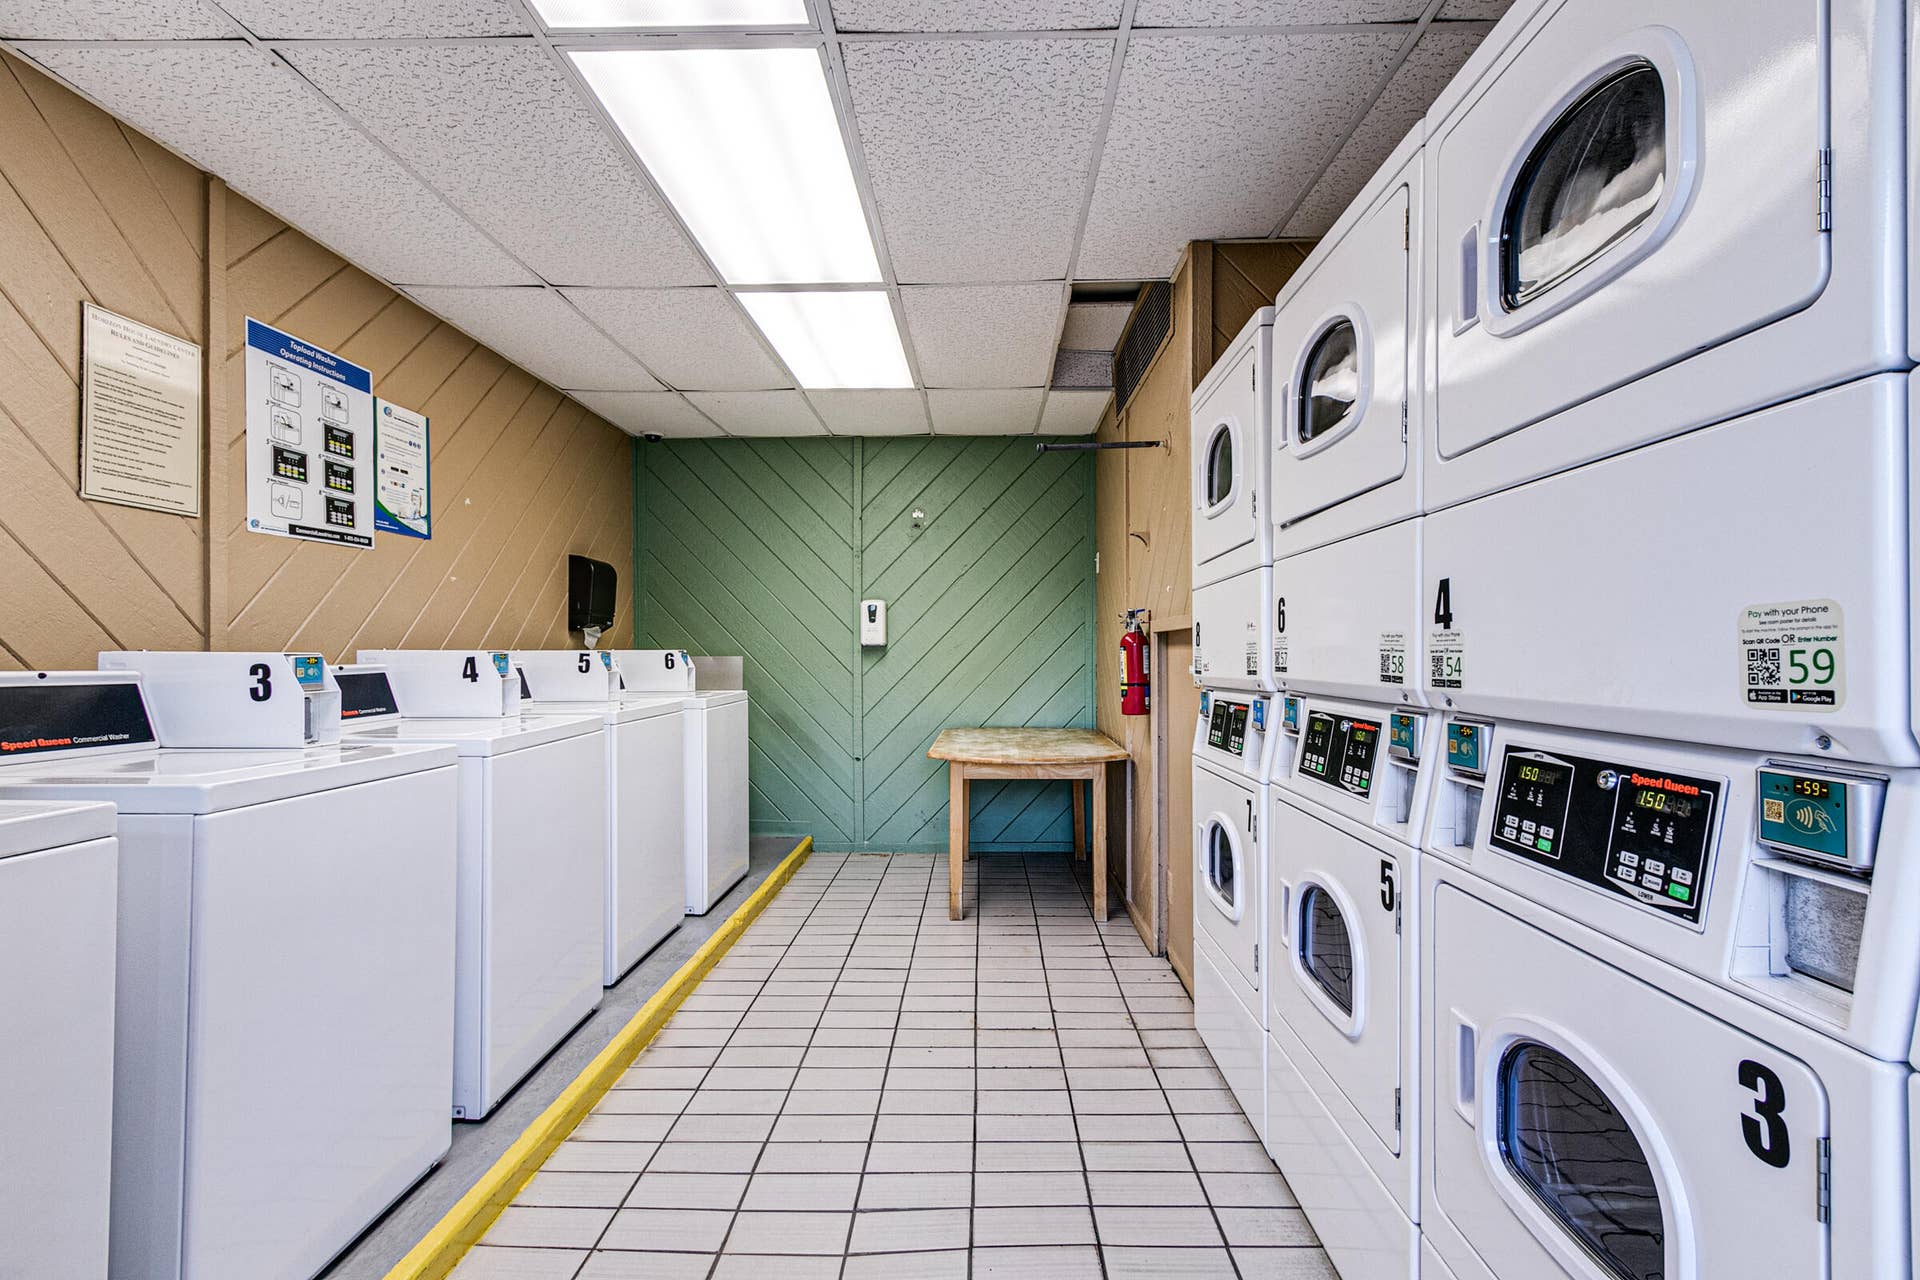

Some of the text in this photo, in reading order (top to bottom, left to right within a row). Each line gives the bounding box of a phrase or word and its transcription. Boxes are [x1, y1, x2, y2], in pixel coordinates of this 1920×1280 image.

[280, 348, 312, 368] Operating
[313, 362, 346, 382] Instructions
[290, 340, 337, 367] Topload Washer
[1278, 597, 1286, 634] 6
[1435, 578, 1453, 630] 4
[1747, 605, 1829, 619] Pay with your Phone
[1195, 622, 1201, 648] 8
[1781, 634, 1796, 644] OR
[462, 656, 478, 683] 4
[578, 653, 591, 674] 5
[665, 653, 675, 670] 6
[1391, 655, 1404, 674] 58
[1446, 656, 1462, 677] 54
[1789, 648, 1835, 684] 59
[250, 663, 272, 702] 3
[1802, 695, 1820, 703] Google
[1, 733, 130, 751] Speed Queen Commercial Washer
[1631, 773, 1699, 796] Speed Queen
[1246, 799, 1252, 833] 7
[1381, 859, 1394, 912] 5
[1637, 890, 1653, 901] LOWER
[1738, 1059, 1790, 1168] 3
